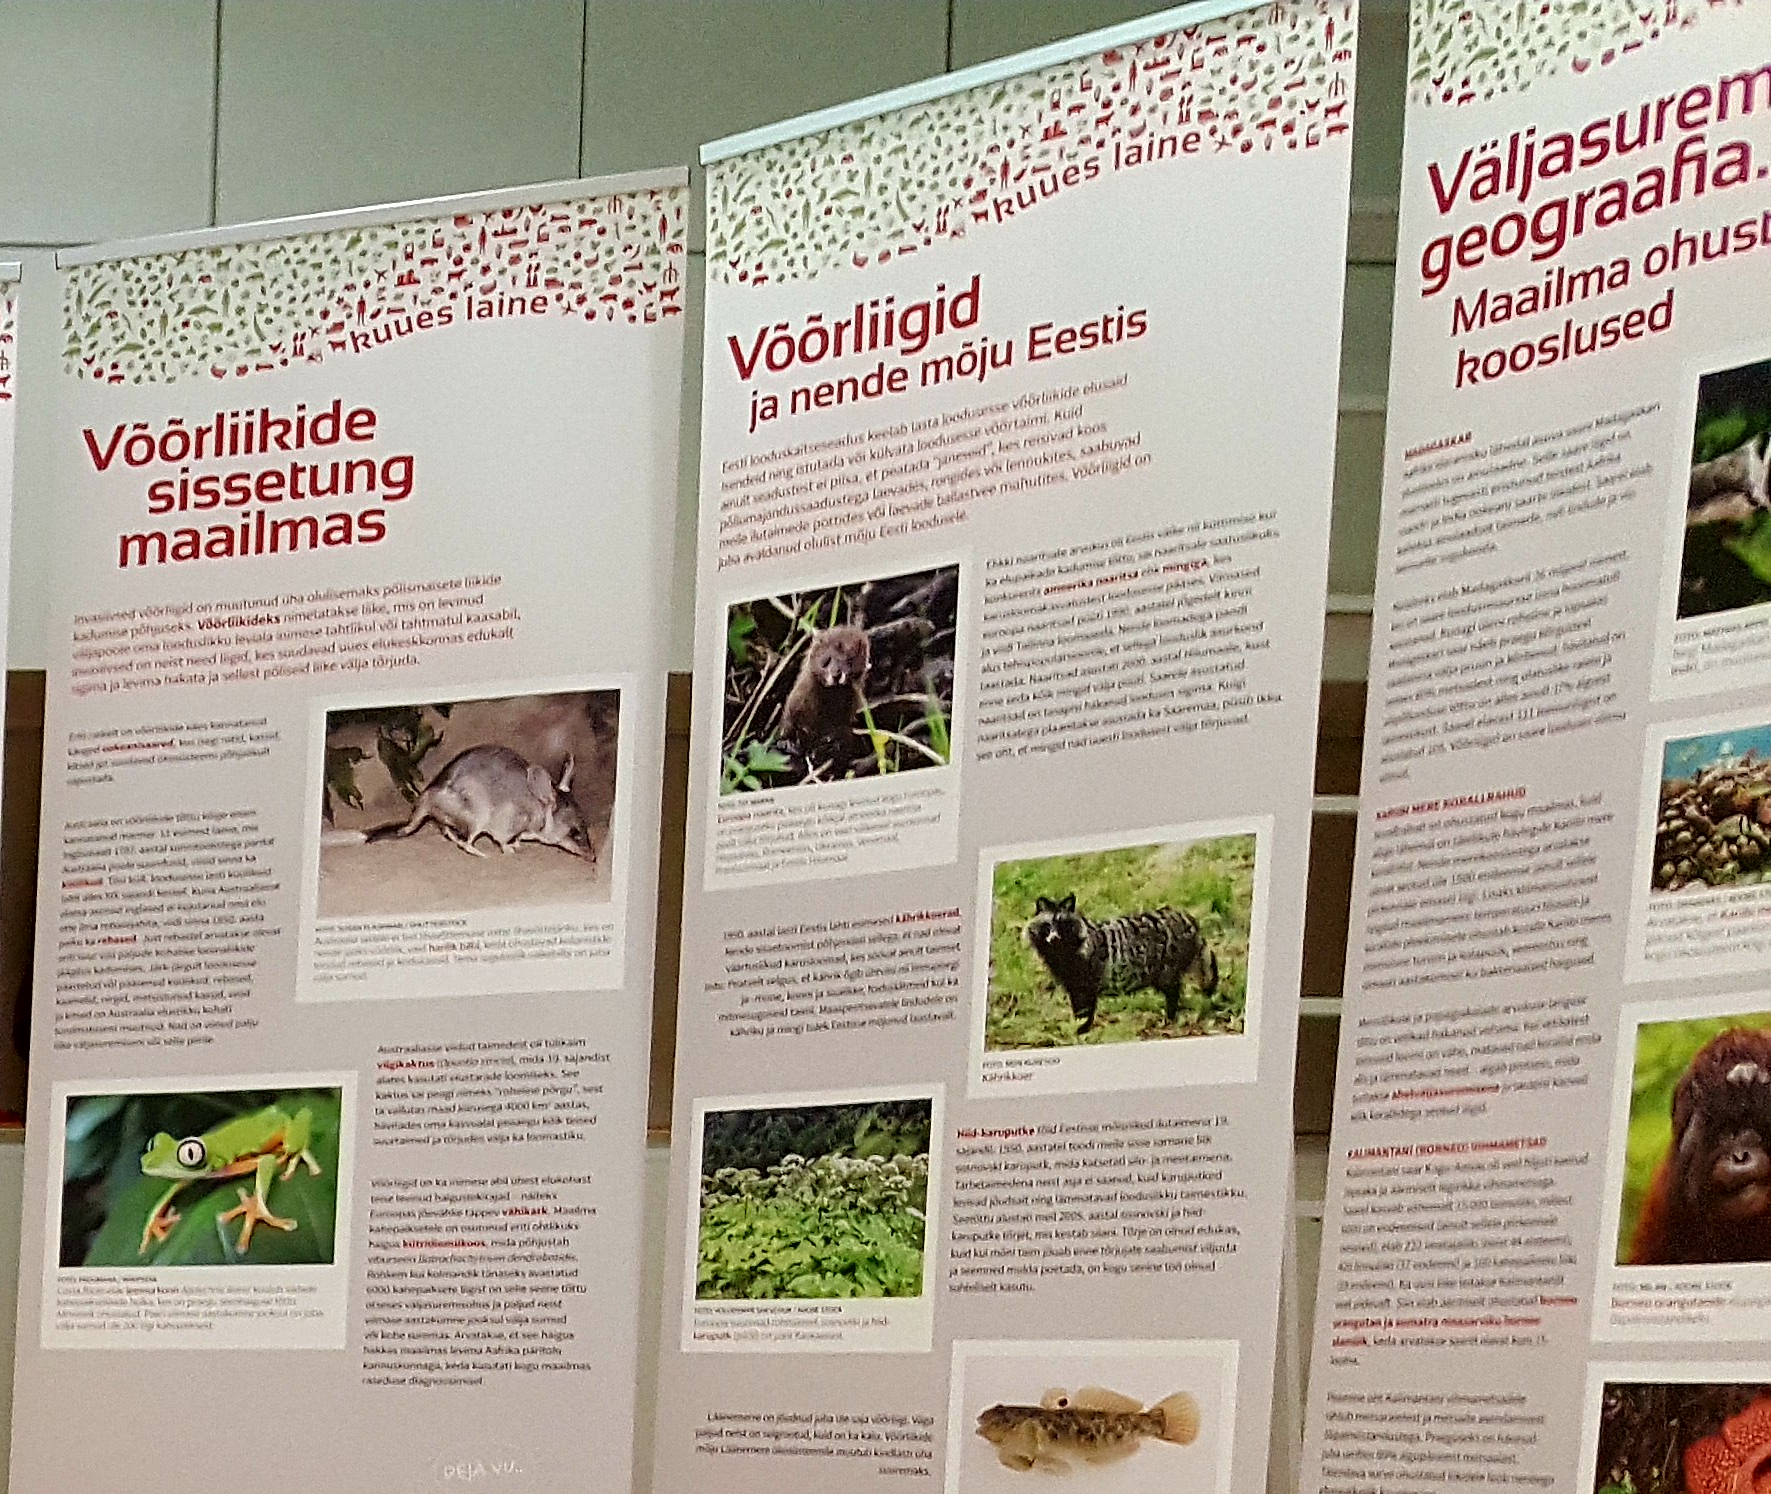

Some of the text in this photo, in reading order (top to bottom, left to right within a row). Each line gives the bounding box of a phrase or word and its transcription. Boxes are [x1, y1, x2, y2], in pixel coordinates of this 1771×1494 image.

[991, 129, 1201, 224] kuues laine
[1421, 136, 1769, 298] geograafia.
[350, 291, 549, 354] kuues laine
[727, 273, 988, 381] Võõrliigid
[1450, 257, 1631, 337] Maailma
[1455, 287, 1675, 389] kooslused
[748, 304, 1148, 434] ja nende mõju Eestis
[82, 398, 377, 475] Võõrliikide
[147, 455, 414, 519] sissetung
[119, 494, 394, 569] maailmas
